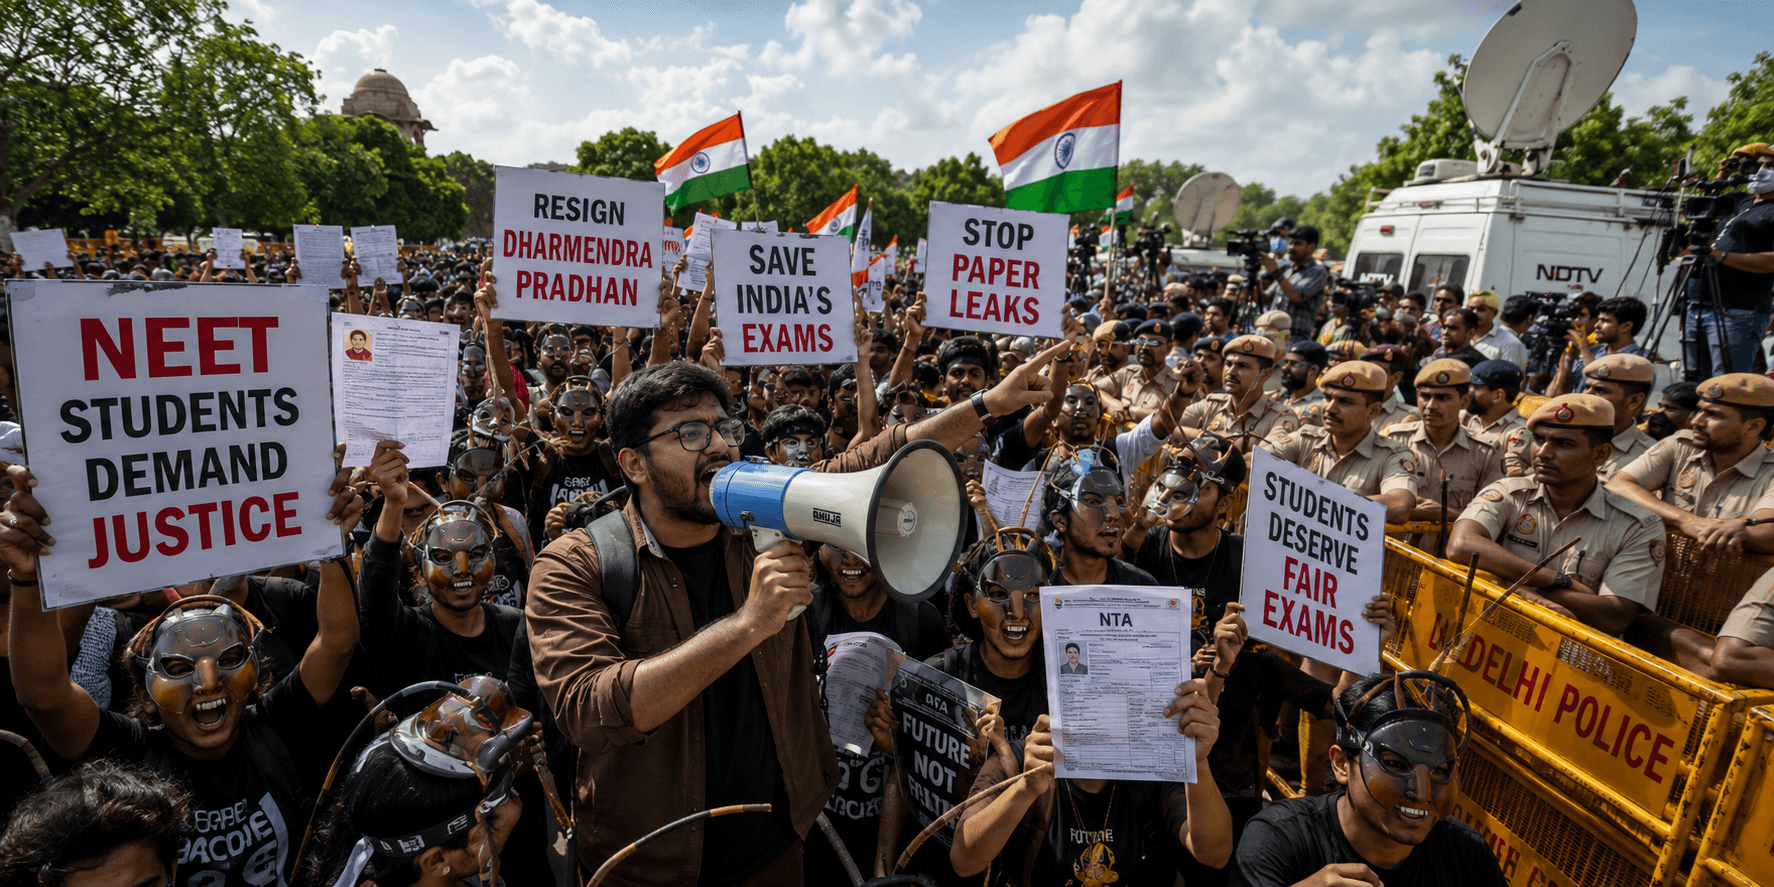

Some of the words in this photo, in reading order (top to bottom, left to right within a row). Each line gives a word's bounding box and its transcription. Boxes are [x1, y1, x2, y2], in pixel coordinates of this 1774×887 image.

[534, 193, 625, 226] RESIGN
[503, 229, 653, 269] DHARMENDRA
[962, 217, 1034, 250] STOP
[749, 244, 817, 277] SAVE
[952, 253, 1040, 290] PAPER
[1537, 264, 1604, 283] NDTV
[516, 270, 638, 306] PRADHAN
[736, 284, 833, 315] INDIA'S
[949, 289, 1040, 325] LEAKS
[80, 316, 279, 381] NEET
[742, 323, 834, 354] EXAMS
[60, 387, 299, 444] STUDENTS
[85, 441, 288, 502] DEMAND
[1264, 471, 1369, 541] STUDENTS
[88, 491, 302, 569] JUSTICE
[1268, 511, 1359, 575] DESERVE
[1283, 555, 1338, 609] FAIR
[1099, 612, 1133, 628] NTA
[1263, 589, 1354, 655] EXAMS
[1460, 634, 1552, 713] DELHI
[1553, 683, 1676, 784] POLICE
[903, 711, 971, 770] FUTURE
[914, 750, 957, 794] NOT
